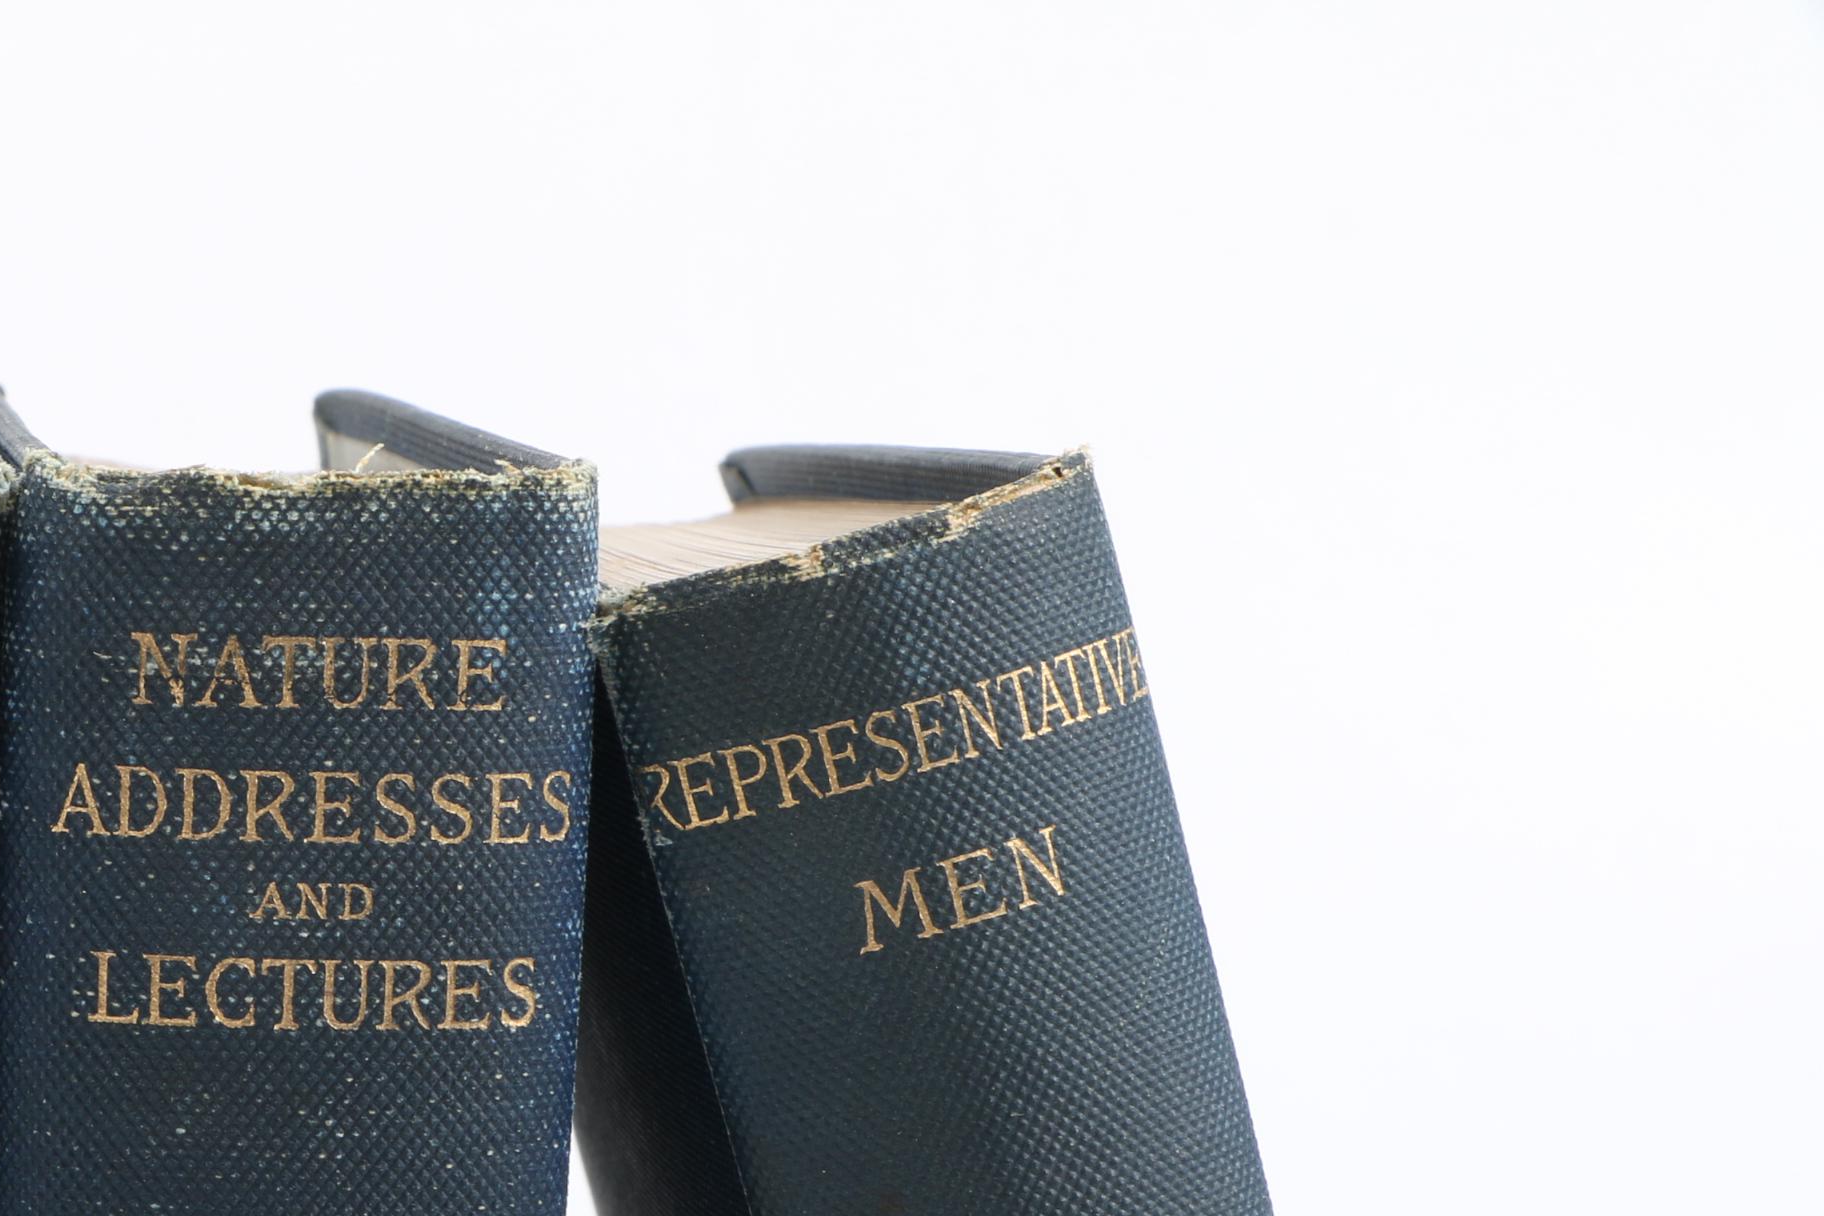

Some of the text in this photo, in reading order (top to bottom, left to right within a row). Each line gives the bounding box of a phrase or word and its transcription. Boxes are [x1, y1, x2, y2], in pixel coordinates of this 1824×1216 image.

[130, 631, 509, 712] NATURE
[638, 626, 1151, 831] REPRESENTATIVE
[50, 762, 572, 846] ADDRESSES
[248, 880, 375, 921] AND
[853, 823, 1066, 955] MEN
[87, 950, 538, 1031] LECTURES
